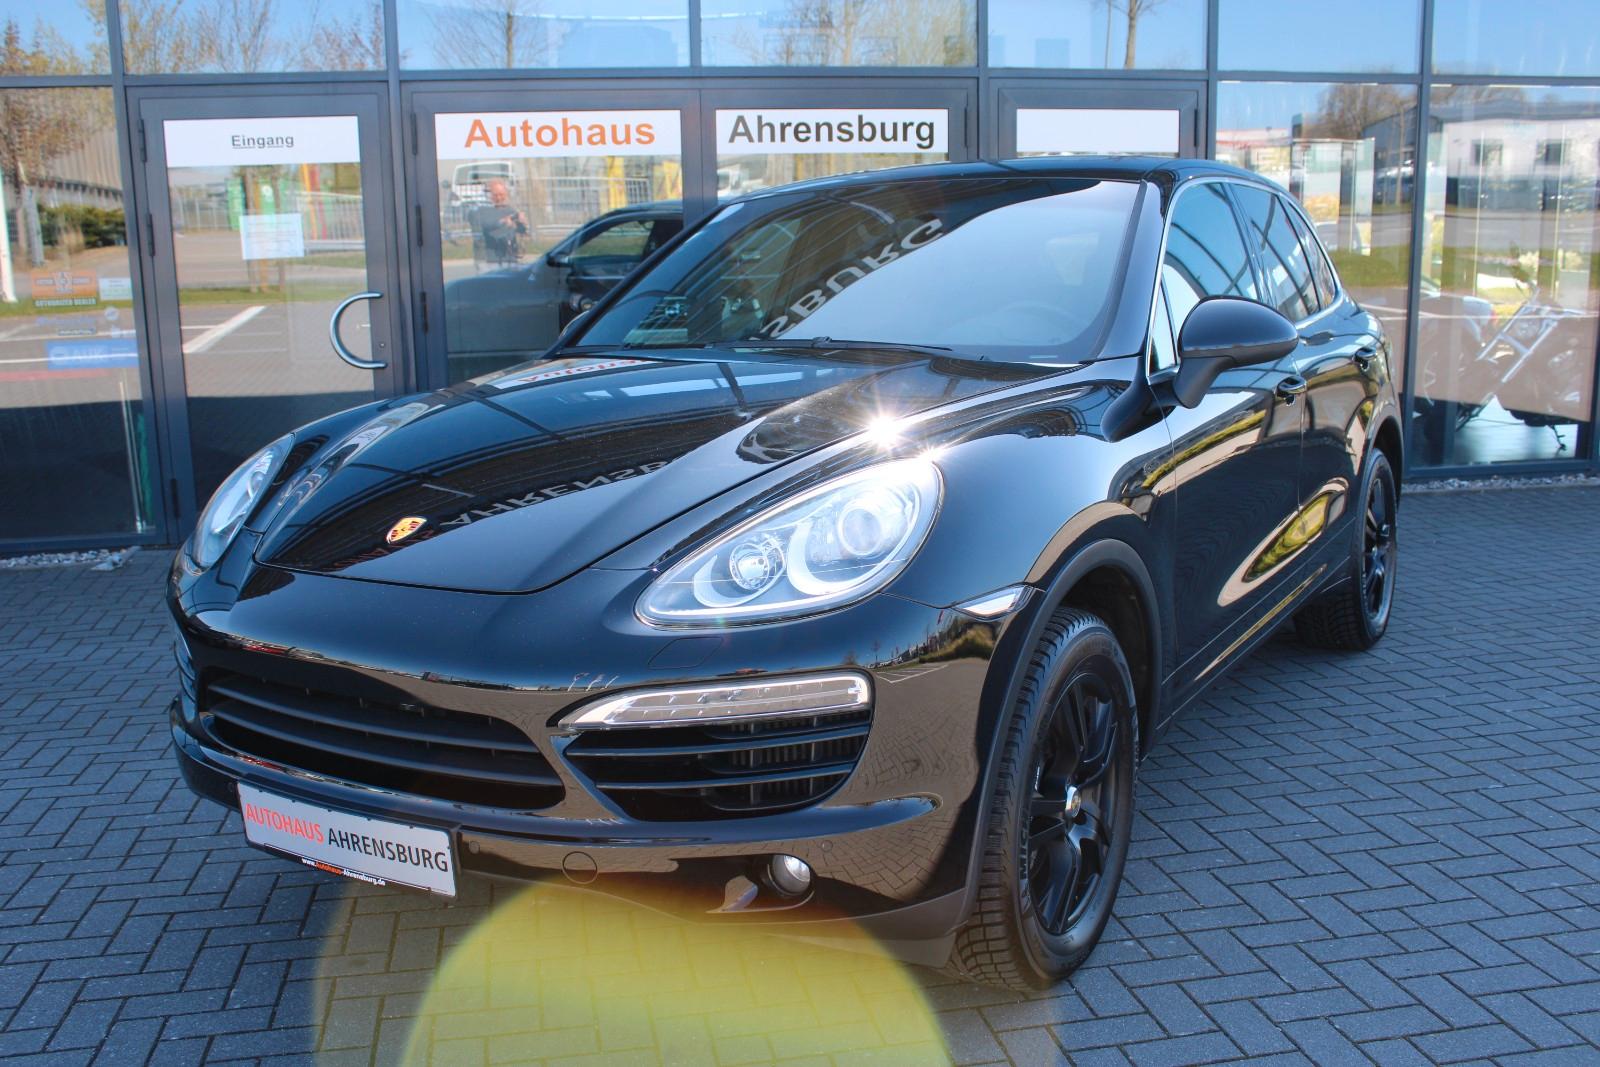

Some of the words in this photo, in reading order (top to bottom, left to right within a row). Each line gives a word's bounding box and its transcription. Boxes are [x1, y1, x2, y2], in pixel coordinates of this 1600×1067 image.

[231, 134, 295, 148] Eingang
[464, 117, 656, 148] Autohaus
[728, 115, 936, 150] Ahrensburg
[245, 803, 325, 844] AUTOHAUS
[328, 828, 449, 872] AHRENSBURG
